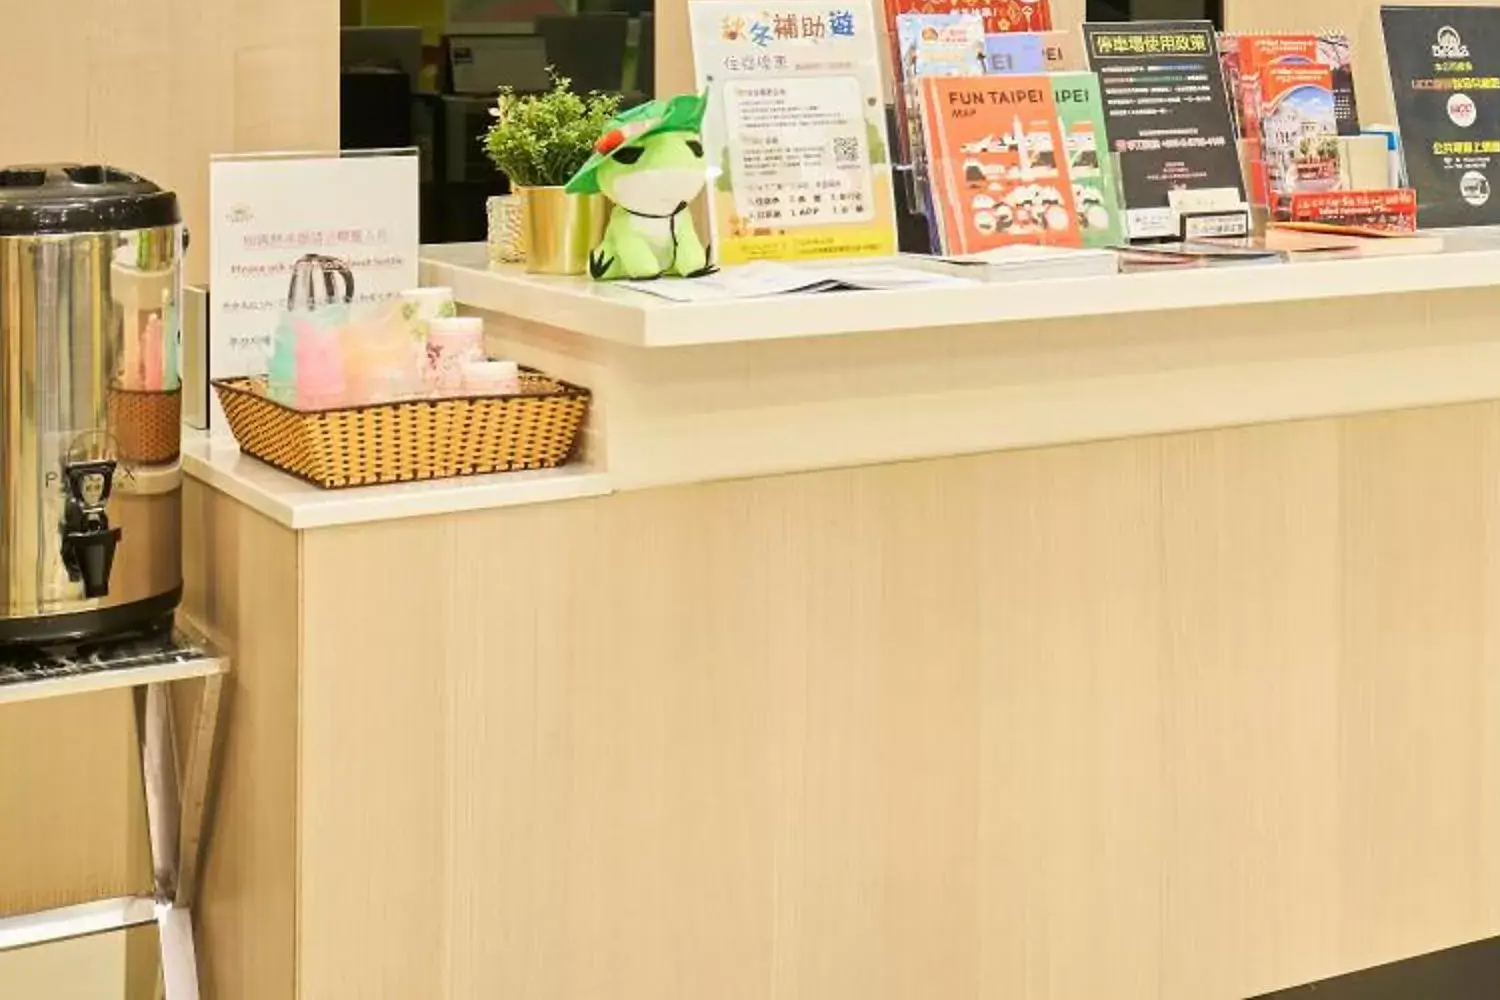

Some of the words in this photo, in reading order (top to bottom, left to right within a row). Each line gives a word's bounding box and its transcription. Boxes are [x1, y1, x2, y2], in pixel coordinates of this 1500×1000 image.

[948, 90, 985, 105] FUN
[988, 88, 1044, 104] TAIPEI
[1055, 89, 1090, 104] IPEI
[952, 108, 977, 118] MAP
